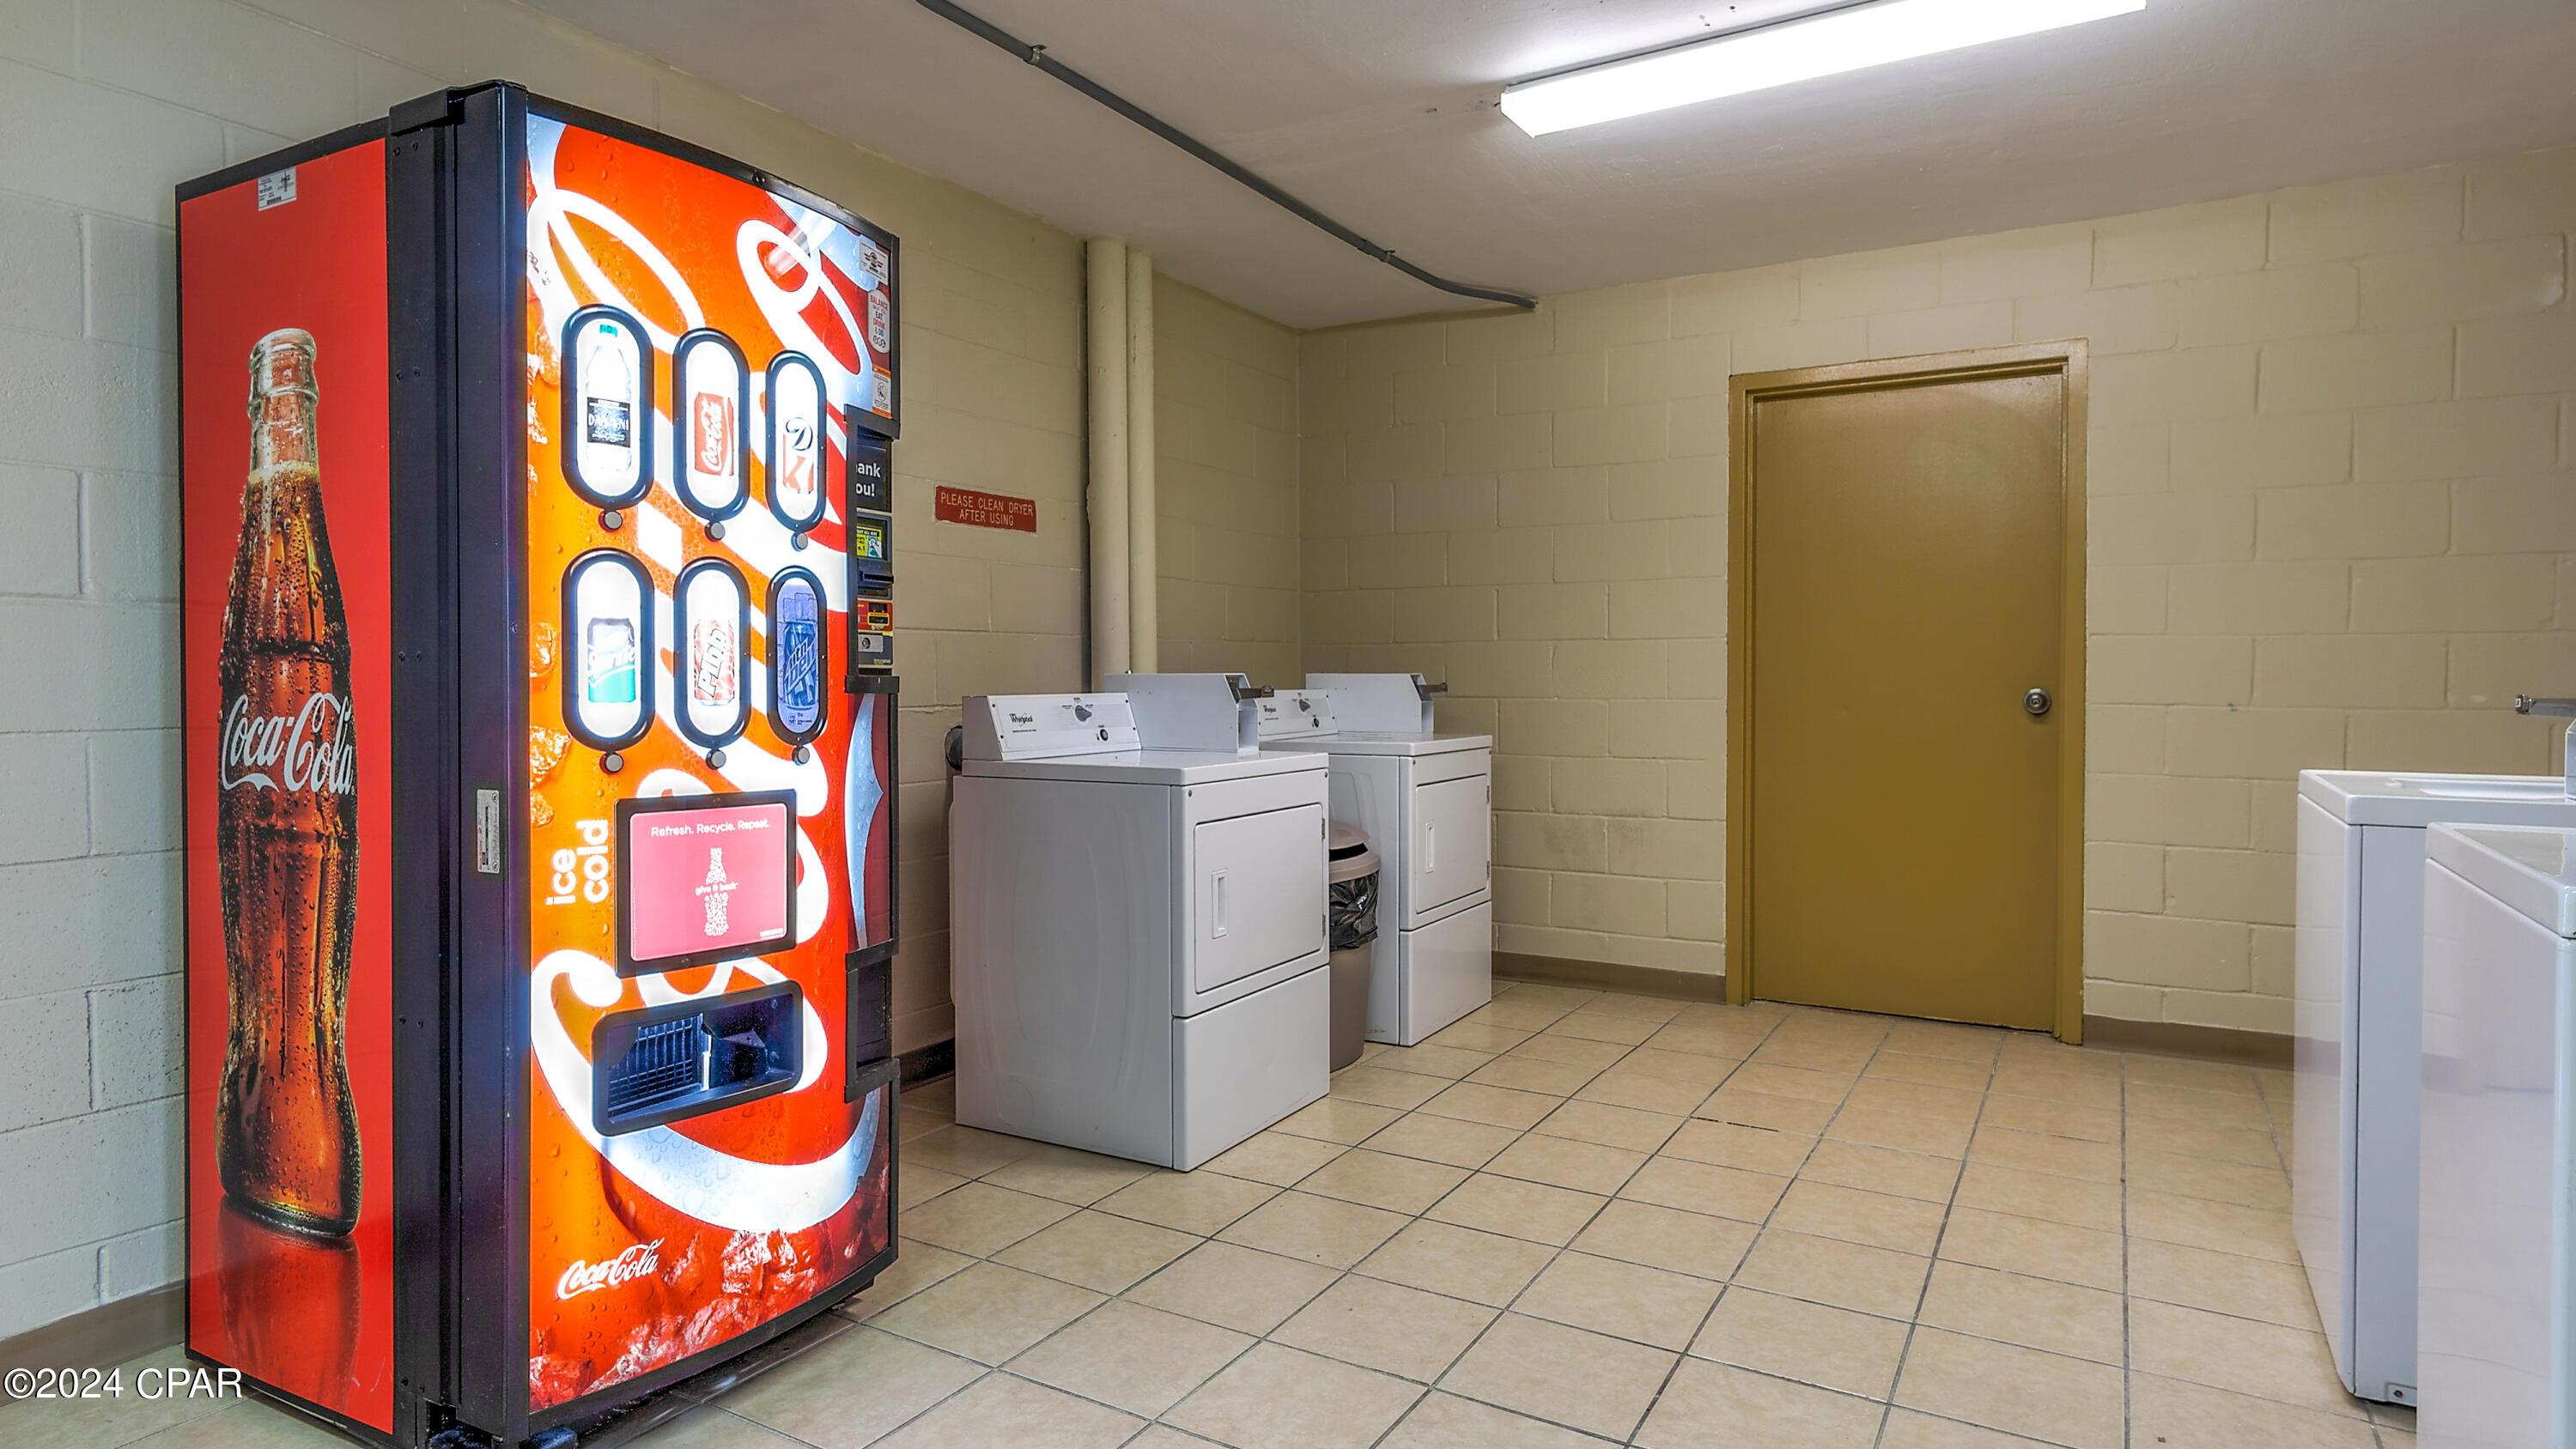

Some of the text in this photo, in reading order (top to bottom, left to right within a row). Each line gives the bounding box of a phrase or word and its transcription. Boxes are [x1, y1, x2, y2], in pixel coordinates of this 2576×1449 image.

[856, 463, 881, 478] ank
[856, 483, 875, 497] ou!
[940, 492, 1033, 516] PLEASE CLEAN DRYER
[959, 508, 1014, 526] AFTER USING
[222, 692, 354, 795] Coca-Cola
[651, 818, 769, 838] Refresh. Recycle. Repeat.
[576, 819, 609, 903] cold
[546, 848, 576, 906] ice
[695, 886, 711, 896] give
[558, 1237, 665, 1300] Coca-Cola
